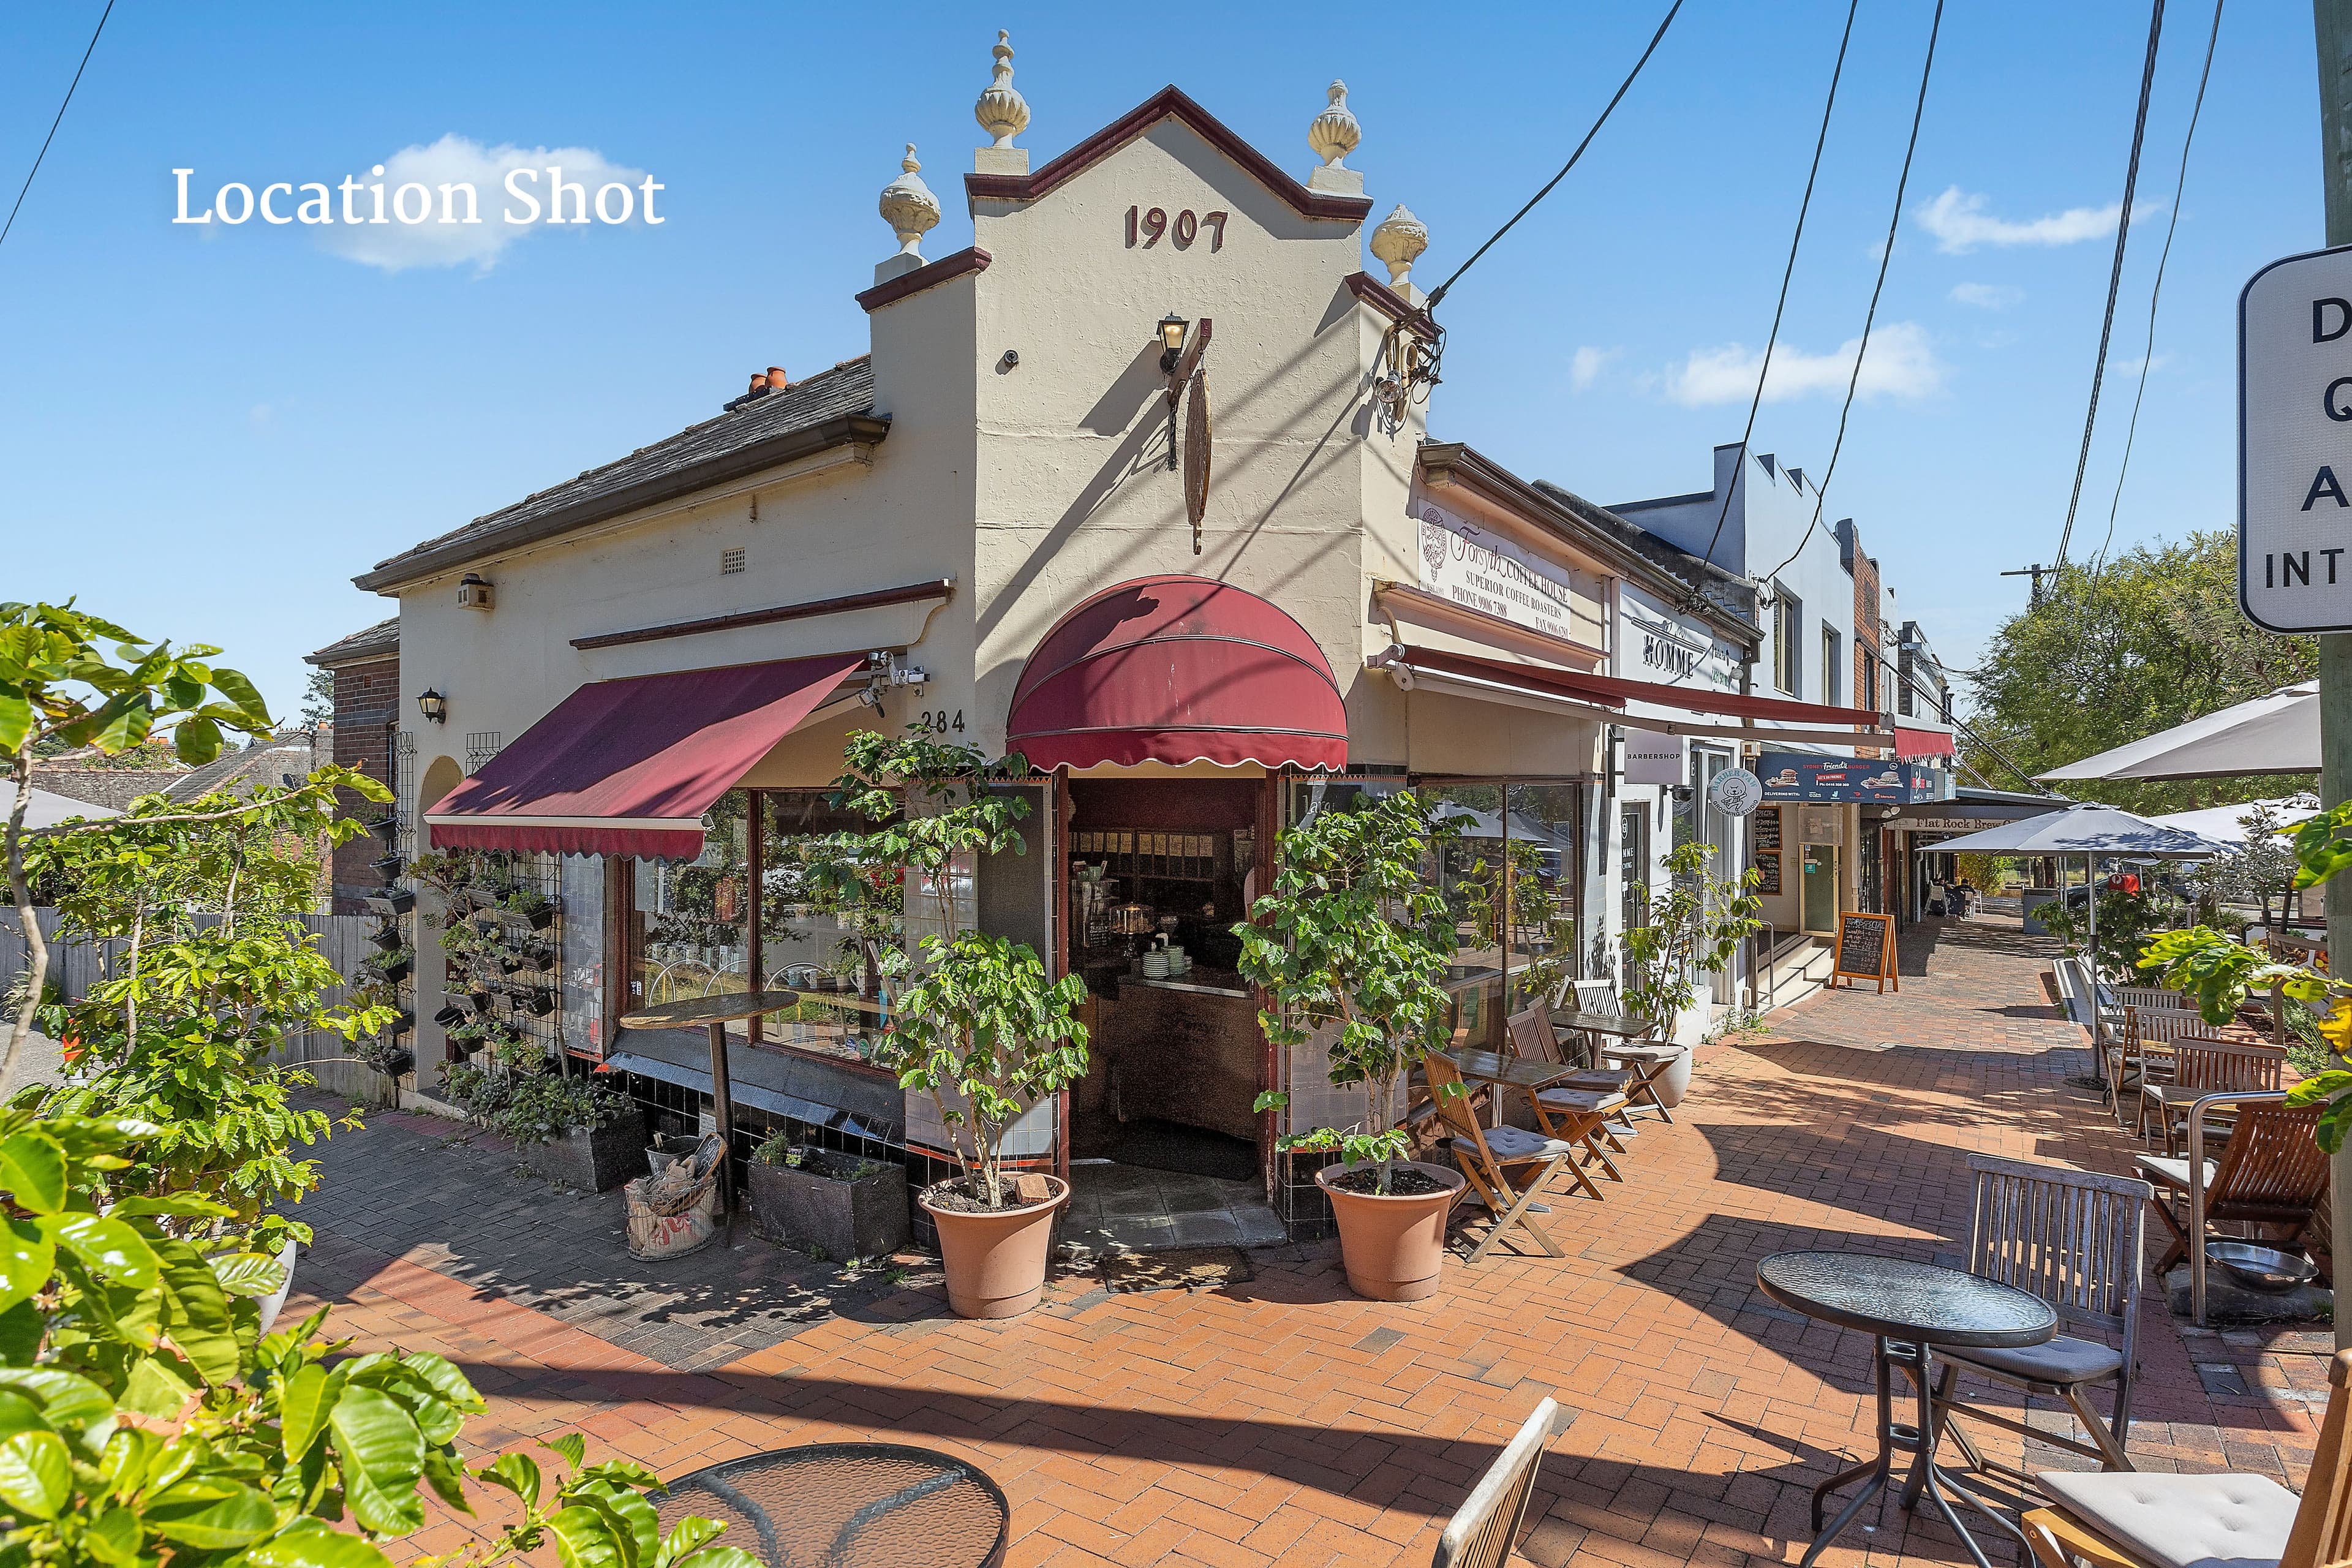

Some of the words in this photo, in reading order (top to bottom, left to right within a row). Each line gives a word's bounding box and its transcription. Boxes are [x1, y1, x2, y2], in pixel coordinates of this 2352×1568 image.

[1130, 205, 1229, 248] 1907
[1450, 526, 1506, 578] Forsyth
[1507, 560, 1539, 590] COFFEE
[1542, 577, 1568, 603] HOUSE
[2266, 548, 2345, 589] INT
[1452, 584, 1477, 609] PHONE
[1478, 597, 1492, 613] 9906
[1493, 601, 1507, 617] 7388
[1466, 570, 1504, 597] SUPERIOR
[1506, 586, 1530, 608] COFFEE
[1531, 597, 1561, 619] ROASTERS
[1535, 616, 1547, 632] FAX
[1644, 634, 1694, 677] HOMME
[921, 709, 965, 734] 284
[1712, 770, 1740, 791] BARBER
[1741, 772, 1758, 788] PAW
[1823, 761, 1848, 771] Friend's
[1713, 800, 1740, 816] GROOMING
[1741, 799, 1758, 815] STUDIO
[1915, 818, 1940, 827] Flat
[1943, 818, 1970, 828] Rock
[1975, 820, 2001, 829] Brew
